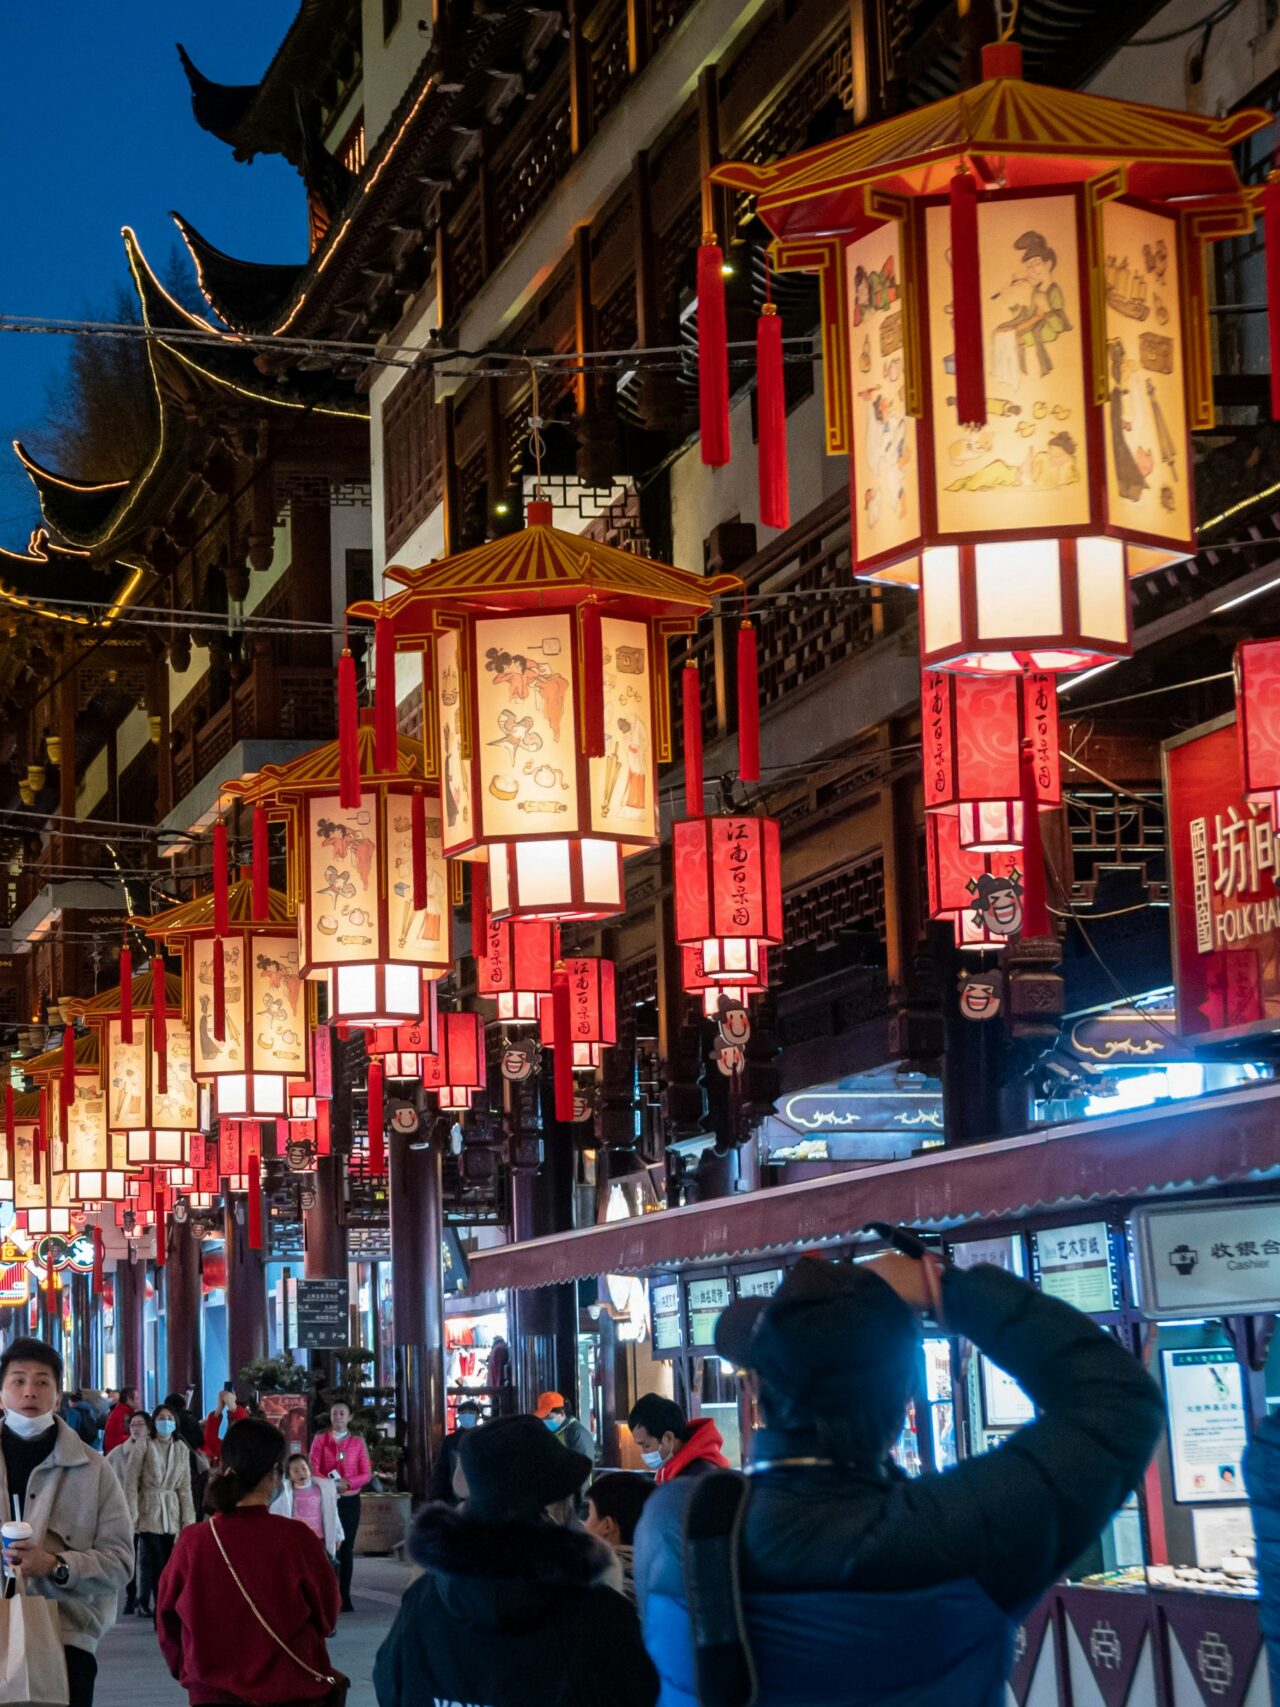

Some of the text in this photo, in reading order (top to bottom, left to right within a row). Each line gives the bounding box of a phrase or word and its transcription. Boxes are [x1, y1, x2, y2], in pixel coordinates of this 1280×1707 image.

[727, 822, 749, 926] 江南百景图
[1216, 903, 1254, 945] FOLK
[574, 961, 591, 1035] 江南百景图
[1210, 1239, 1280, 1259] 收银台
[1226, 1260, 1270, 1271] Cashier
